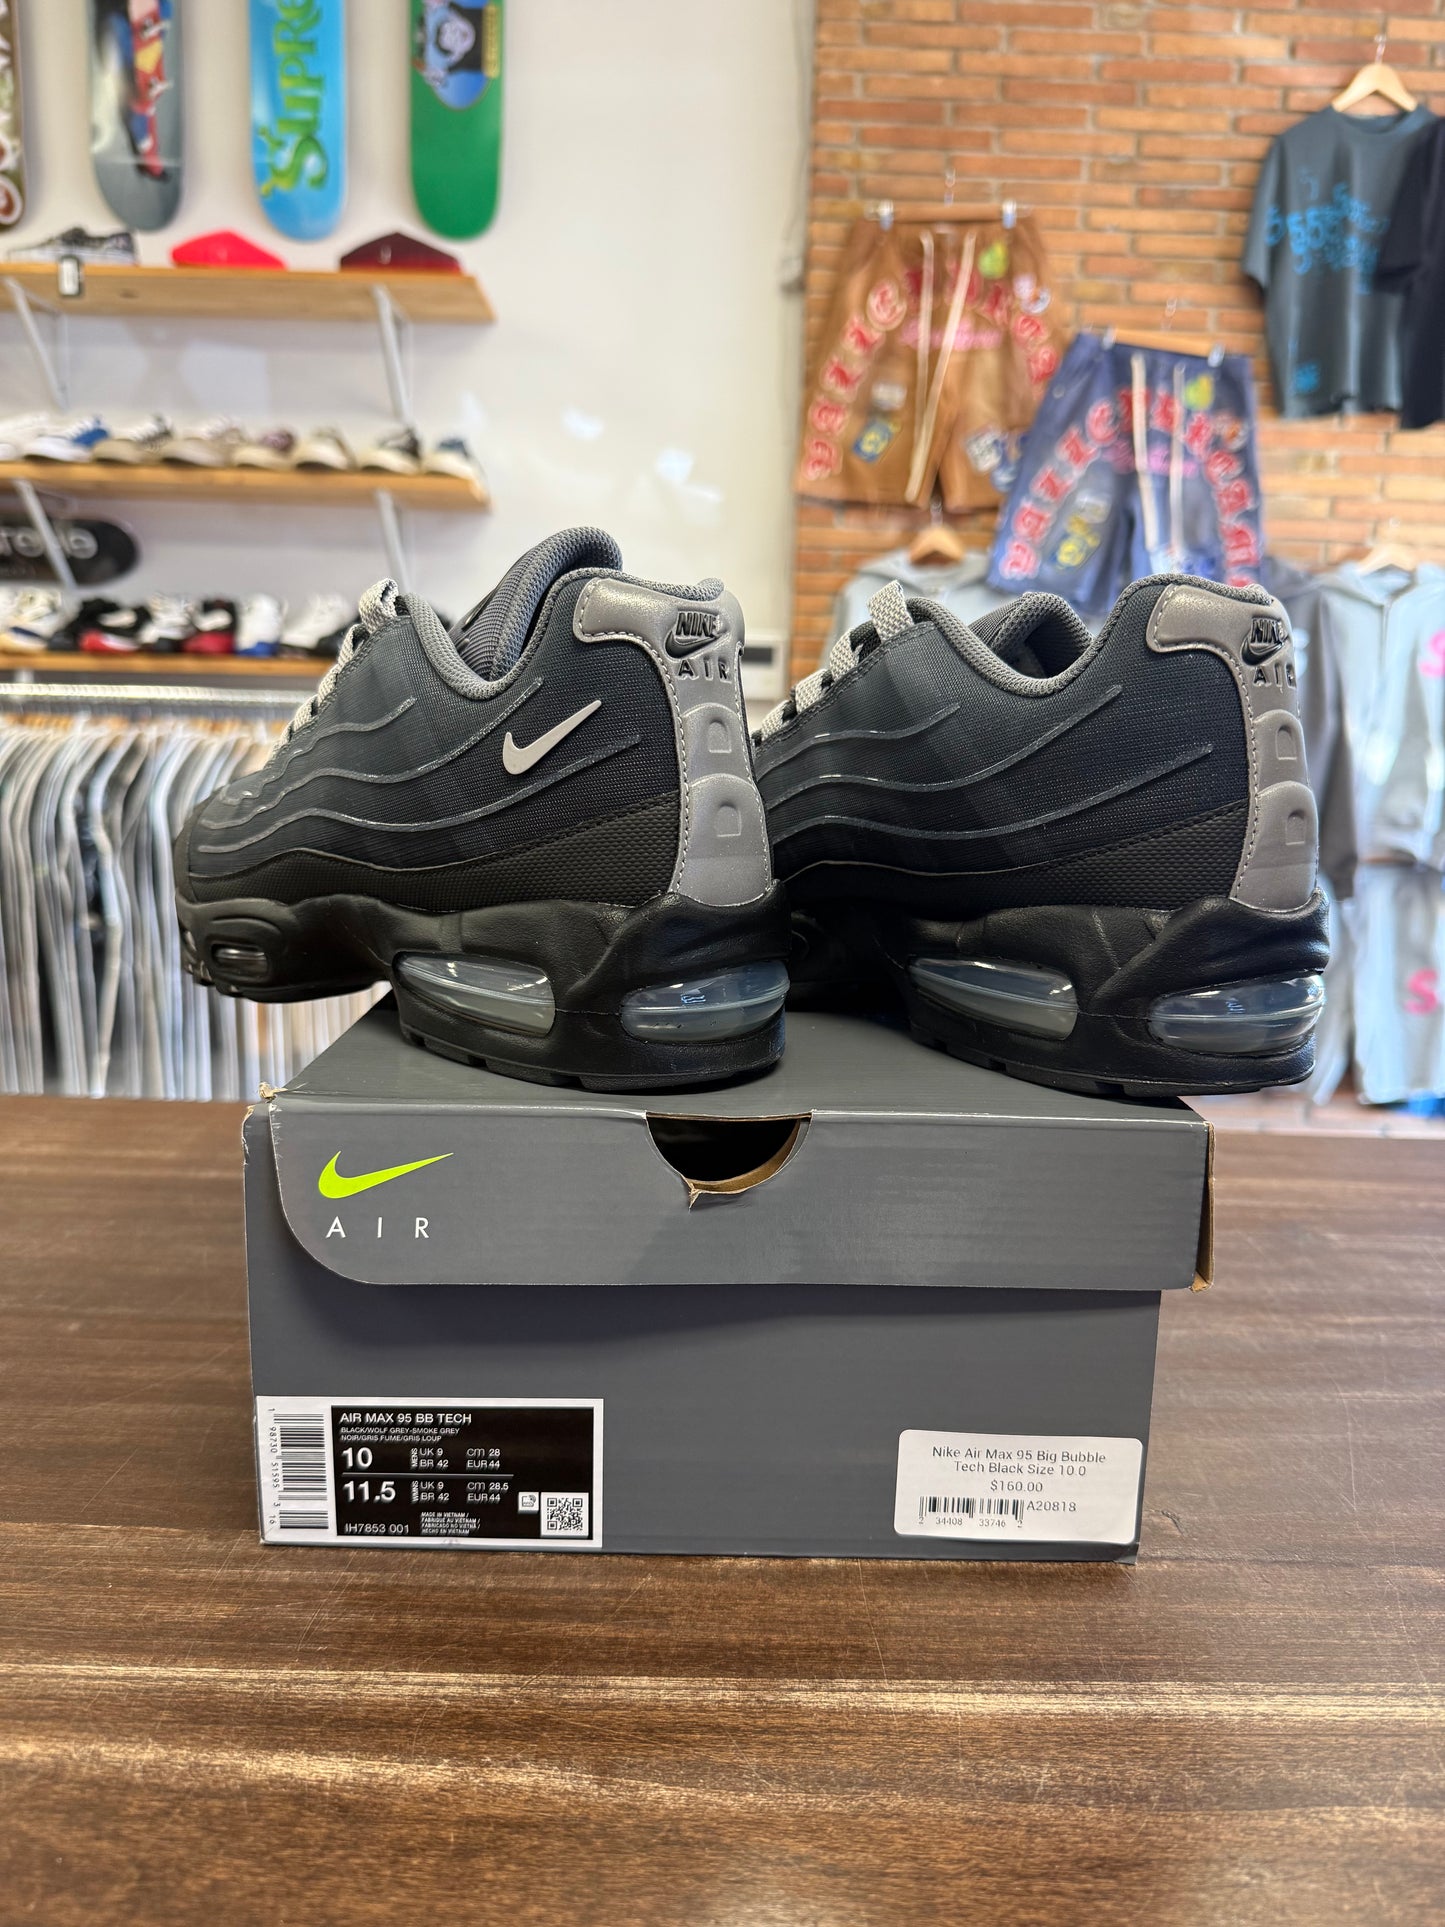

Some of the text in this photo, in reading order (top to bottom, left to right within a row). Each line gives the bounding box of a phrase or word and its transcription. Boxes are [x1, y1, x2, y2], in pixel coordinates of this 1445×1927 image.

[678, 656, 732, 683] AIR
[340, 1412, 472, 1424] AIR MAX 95 BB TECH
[269, 1426, 278, 1453] 98730
[342, 1447, 373, 1467] 10
[410, 1447, 418, 1467] MENS
[420, 1448, 444, 1456] UK 9
[489, 1448, 501, 1457] 28
[932, 1446, 1106, 1463] Nike Air Max 95 Big Bubble
[420, 1459, 449, 1468] BR 42
[467, 1460, 500, 1468] EUR 44
[954, 1460, 984, 1473] Tech
[989, 1462, 1024, 1474] Black
[1027, 1463, 1054, 1475] Size
[271, 1462, 280, 1488] 51595
[343, 1480, 396, 1501] 11.5
[411, 1480, 419, 1502] WMNS
[420, 1481, 444, 1489] UK 9
[489, 1482, 509, 1490] 28.5
[990, 1480, 1043, 1493] $160.00
[421, 1493, 450, 1501] BR 42
[468, 1493, 501, 1501] EUR 44
[1026, 1500, 1077, 1513] A20818
[269, 1515, 276, 1525] 16
[979, 1518, 1006, 1528] 33746
[345, 1523, 410, 1534] IH7853 001
